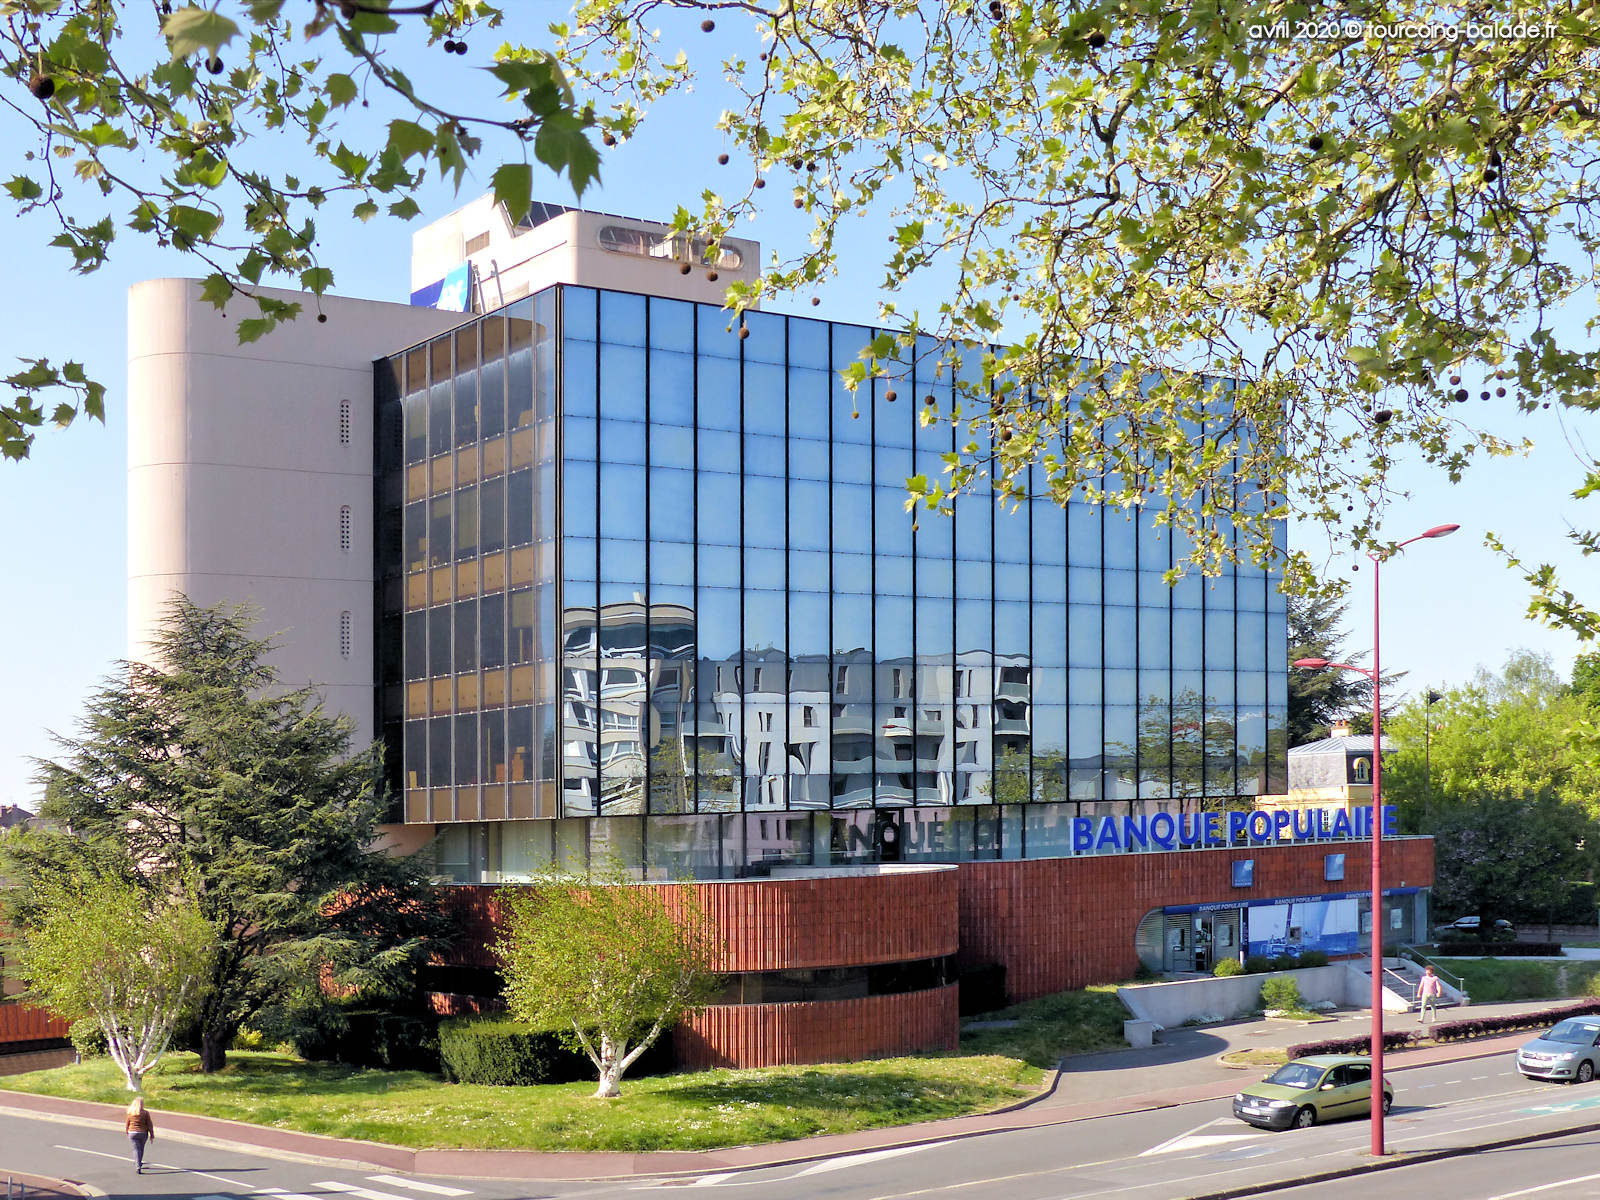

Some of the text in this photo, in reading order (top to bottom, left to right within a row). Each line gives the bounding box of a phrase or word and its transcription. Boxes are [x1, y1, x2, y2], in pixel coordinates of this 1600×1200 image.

[1070, 812, 1219, 851] BANQUE
[1226, 804, 1398, 842] POPULAIRE
[1221, 902, 1249, 910] POPULAIRE
